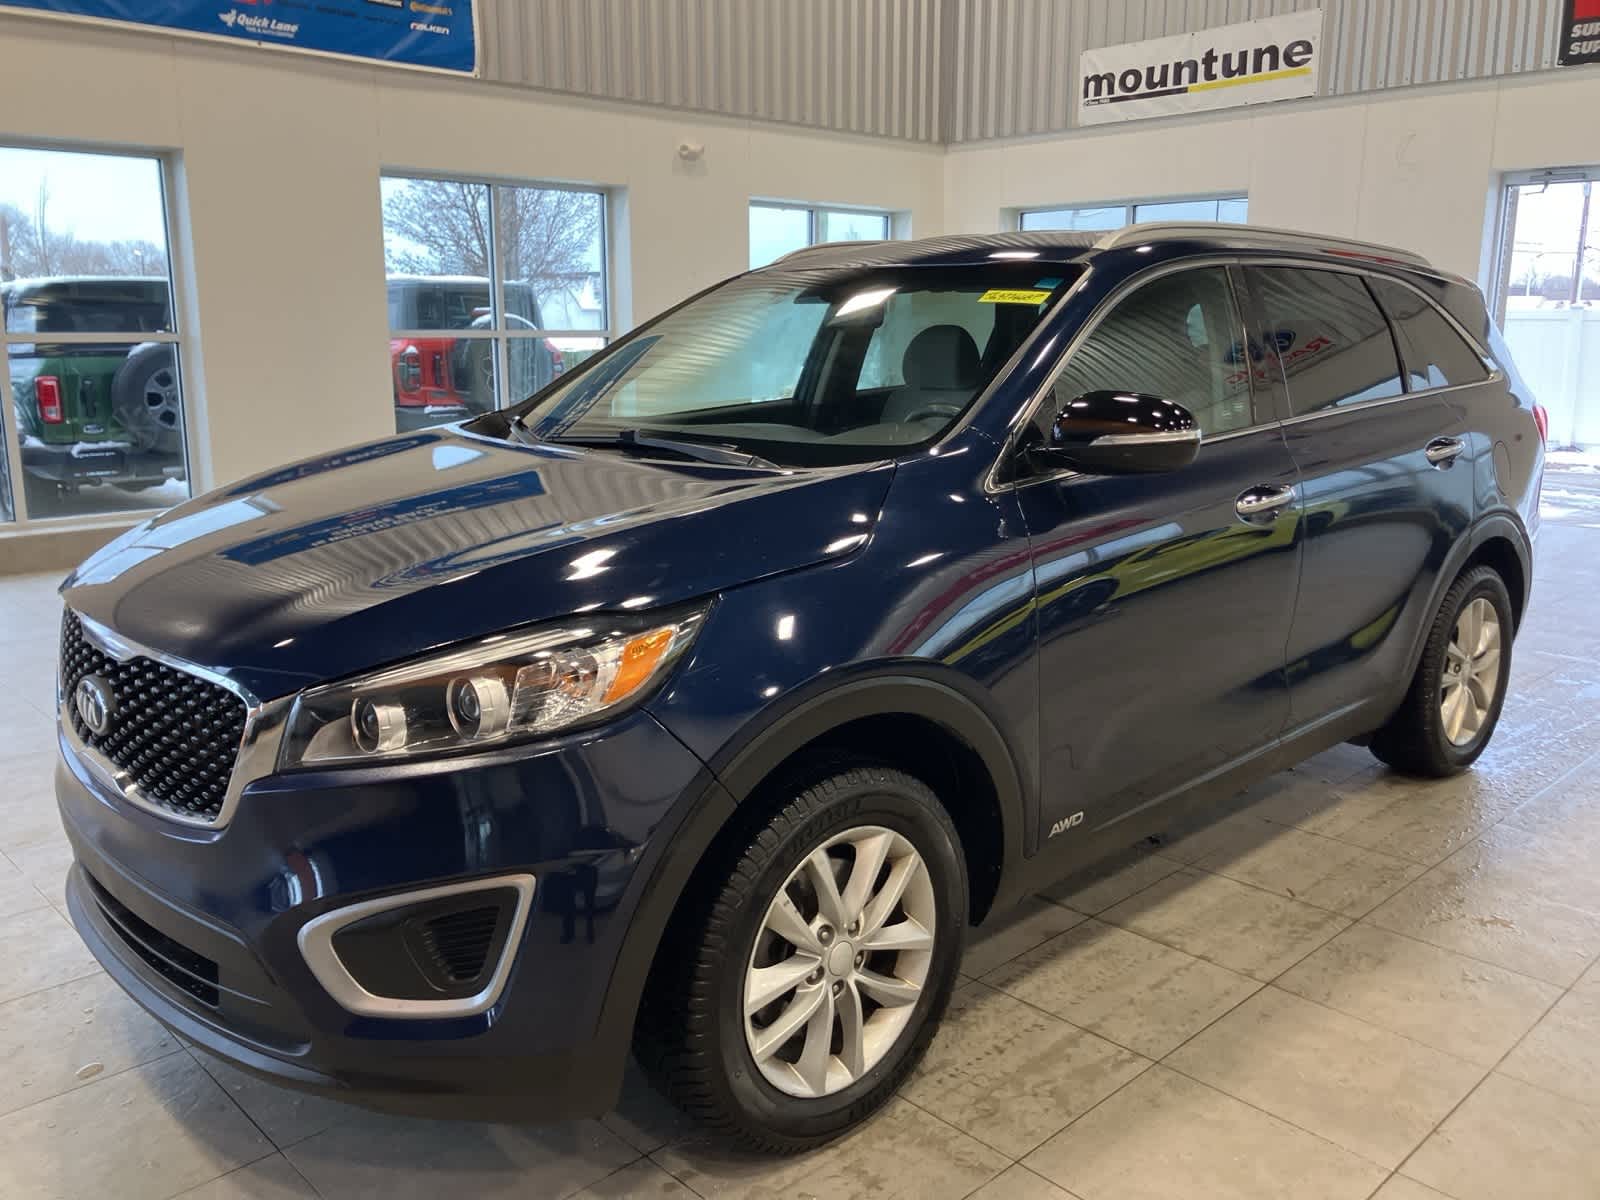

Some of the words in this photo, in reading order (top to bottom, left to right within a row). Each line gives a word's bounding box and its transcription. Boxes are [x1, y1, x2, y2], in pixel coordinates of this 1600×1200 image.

[237, 14, 269, 28] Quick
[269, 19, 298, 33] Lane
[410, 22, 450, 35] FALKEN
[1083, 39, 1313, 98] mountune
[1048, 811, 1084, 839] AWD
